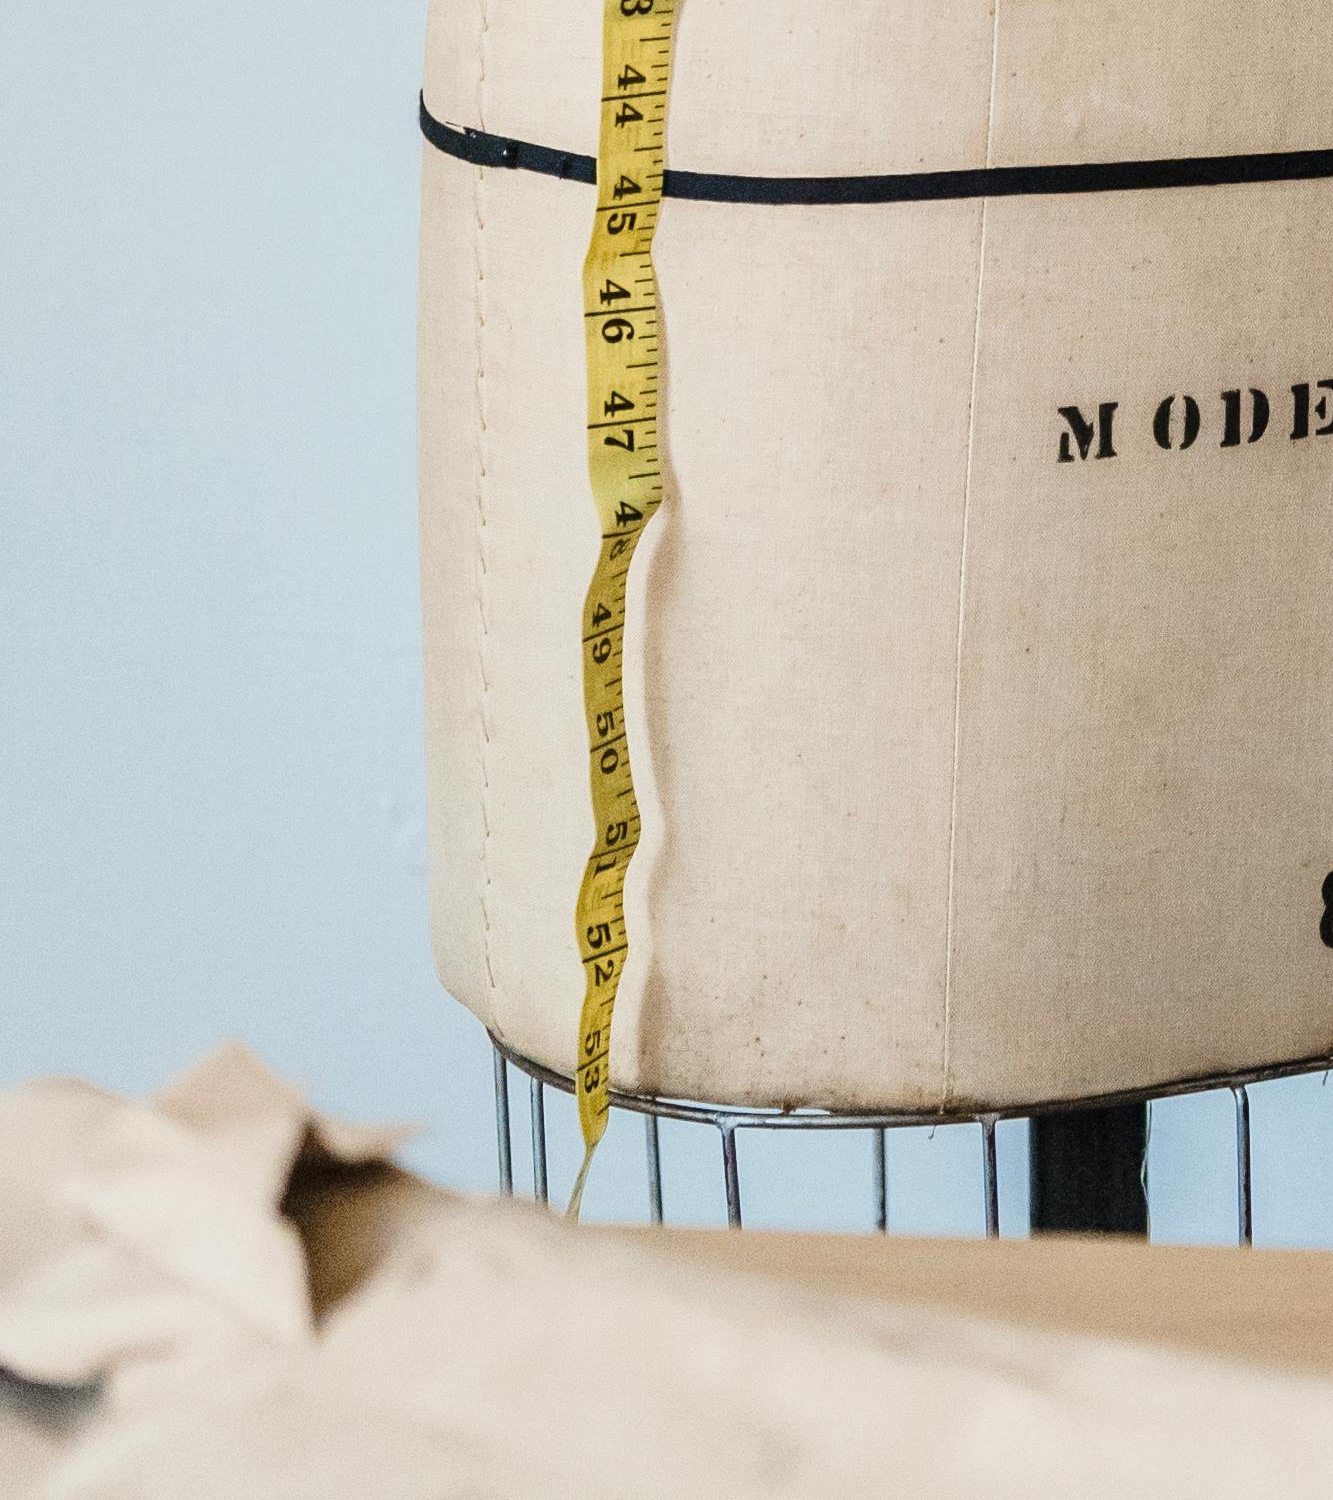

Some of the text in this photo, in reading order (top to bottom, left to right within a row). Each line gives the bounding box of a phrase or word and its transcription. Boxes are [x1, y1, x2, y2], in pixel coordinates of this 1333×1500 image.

[617, 64, 646, 128] 44
[608, 175, 641, 235] 45
[601, 279, 635, 344] 46
[604, 391, 634, 453] 47
[609, 501, 643, 561] 48
[592, 602, 613, 665] 49
[597, 710, 619, 774] 50
[593, 822, 628, 875] 51
[588, 923, 615, 987] 52
[584, 1031, 601, 1094] 53
